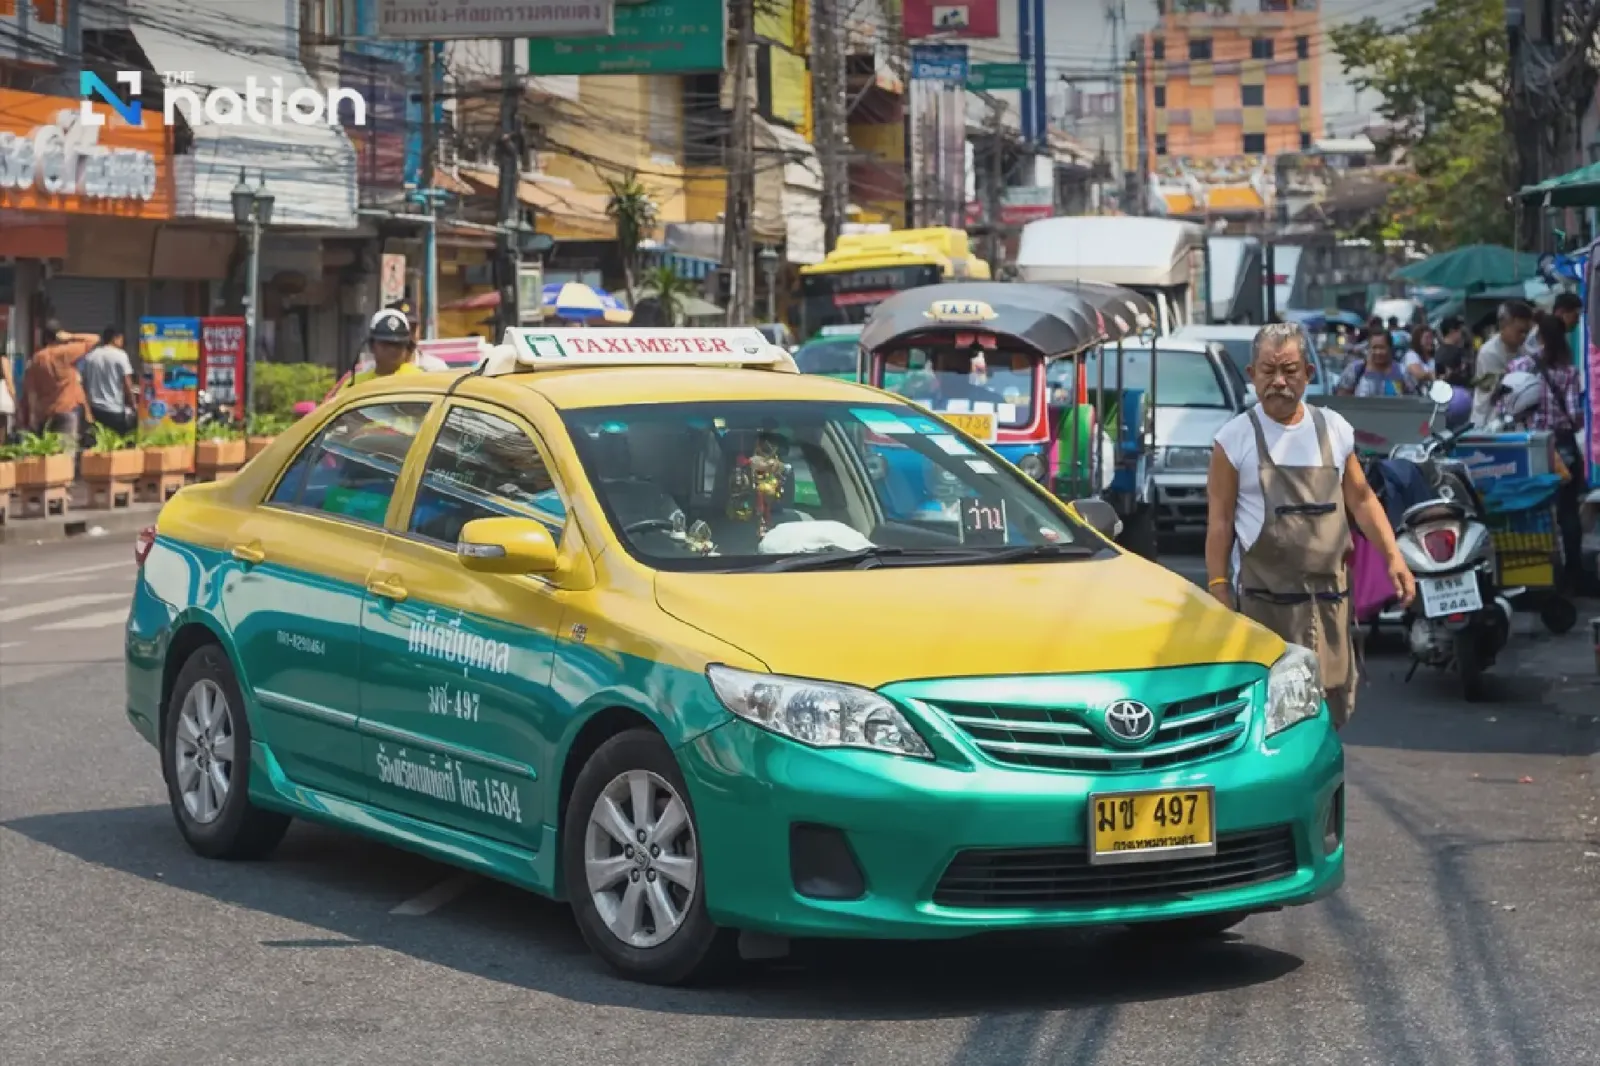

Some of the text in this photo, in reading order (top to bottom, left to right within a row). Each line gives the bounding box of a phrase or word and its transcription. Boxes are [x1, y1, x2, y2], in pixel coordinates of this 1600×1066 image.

[384, 0, 602, 25] ผิวหนัง-ศัลยกรรมตกแตง
[940, 303, 979, 315] TAXI
[204, 339, 240, 352] VISA
[1097, 794, 1199, 832] มช 497
[1113, 834, 1196, 850] กรงเทพมหานคร
